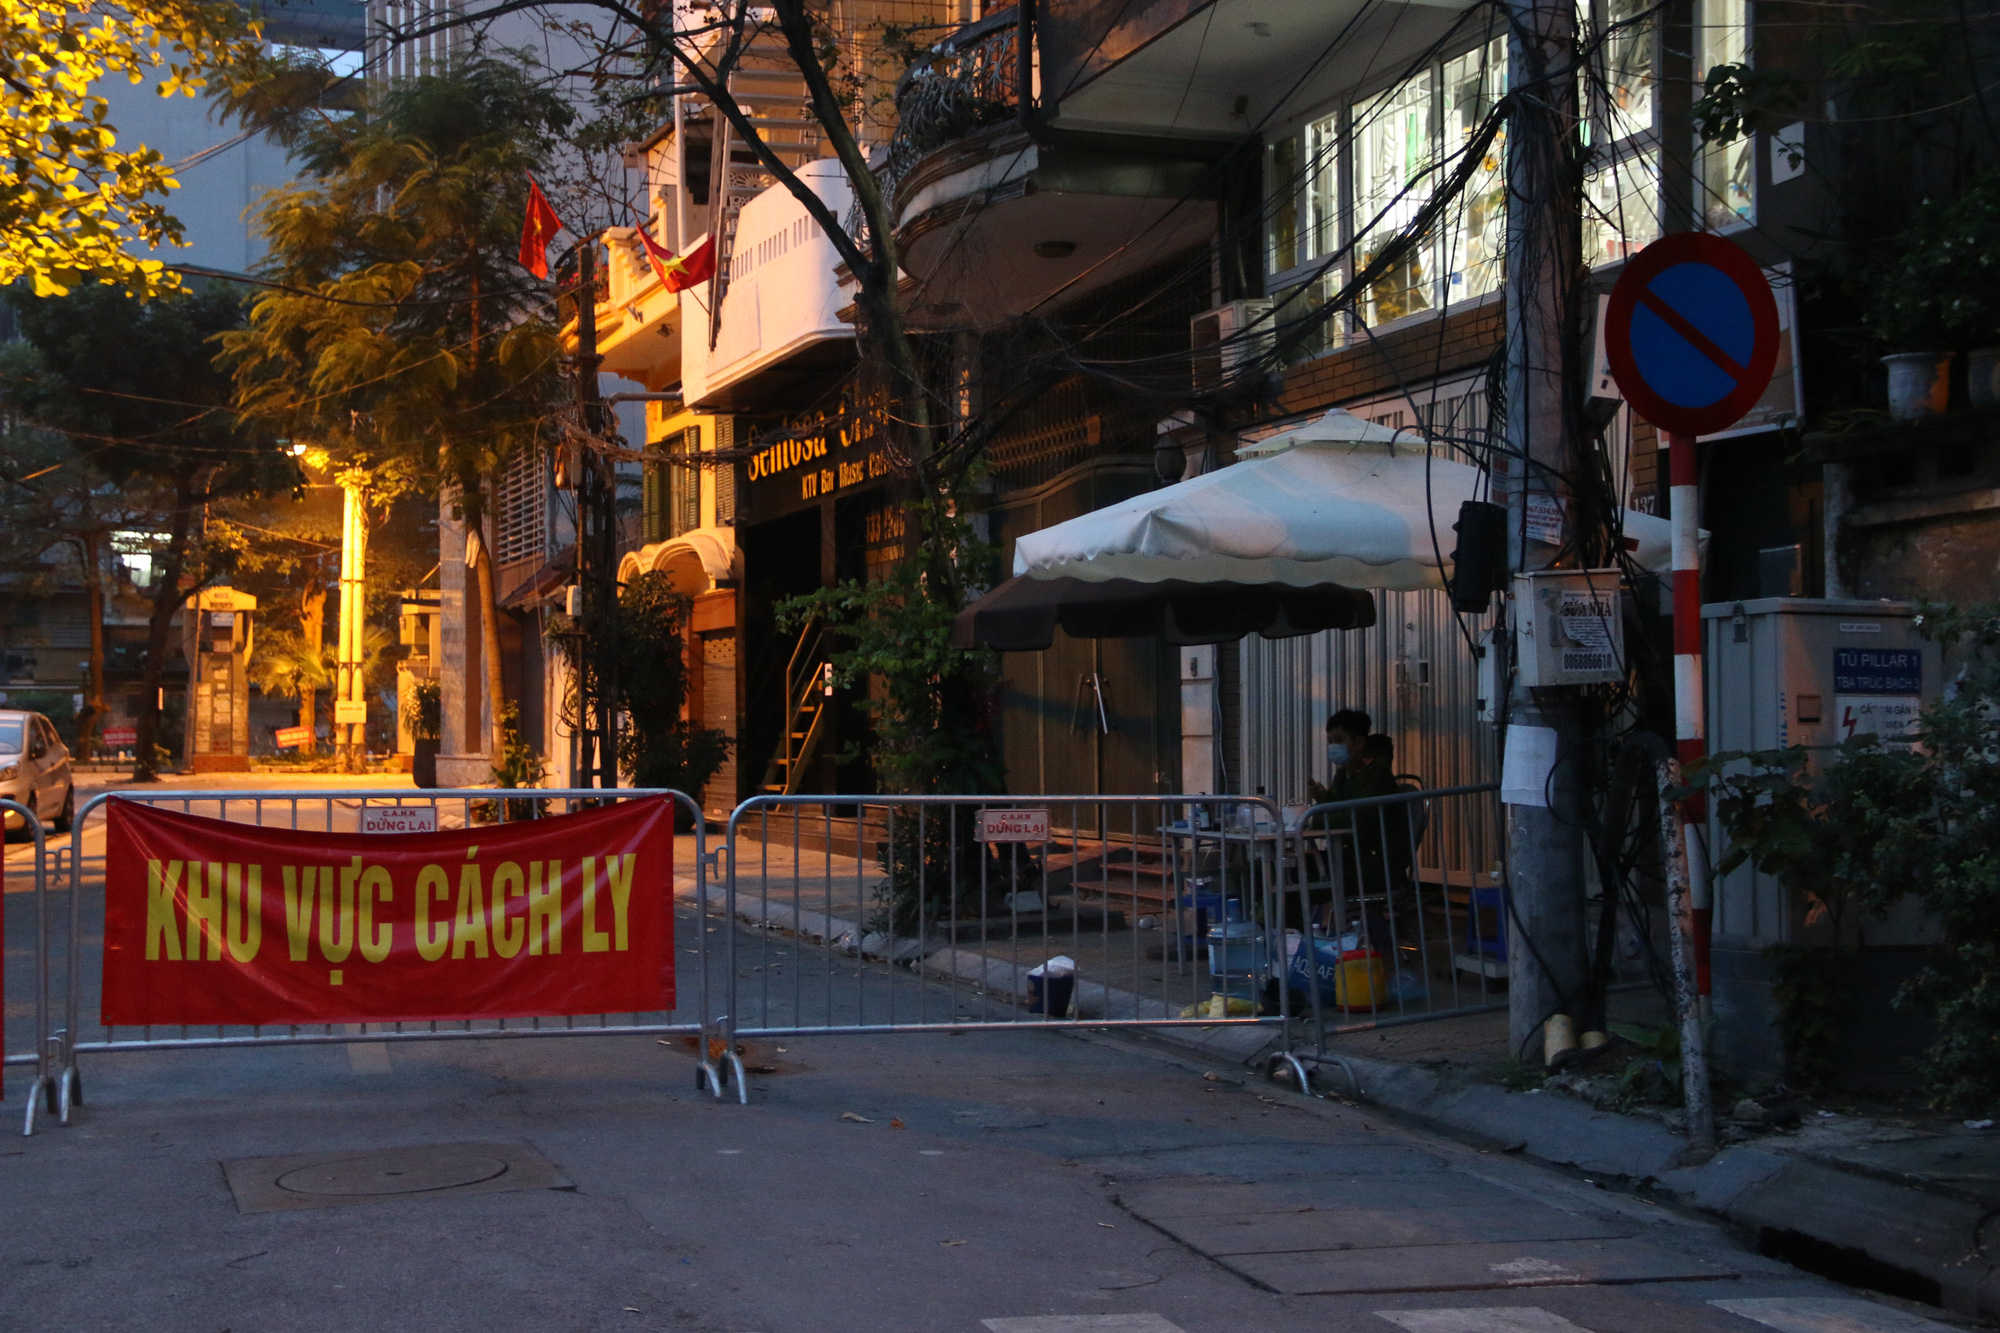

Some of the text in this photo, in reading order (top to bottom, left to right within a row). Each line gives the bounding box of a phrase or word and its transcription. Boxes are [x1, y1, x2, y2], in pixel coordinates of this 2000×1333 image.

[802, 472, 817, 500] KTV
[821, 468, 834, 495] Bar
[1633, 494, 1656, 515] 137
[1839, 651, 1917, 667] TỦ PILLAR 1
[382, 810, 417, 818] C.A.H.N
[145, 845, 636, 986] KHU VỰC CÁCH LY
